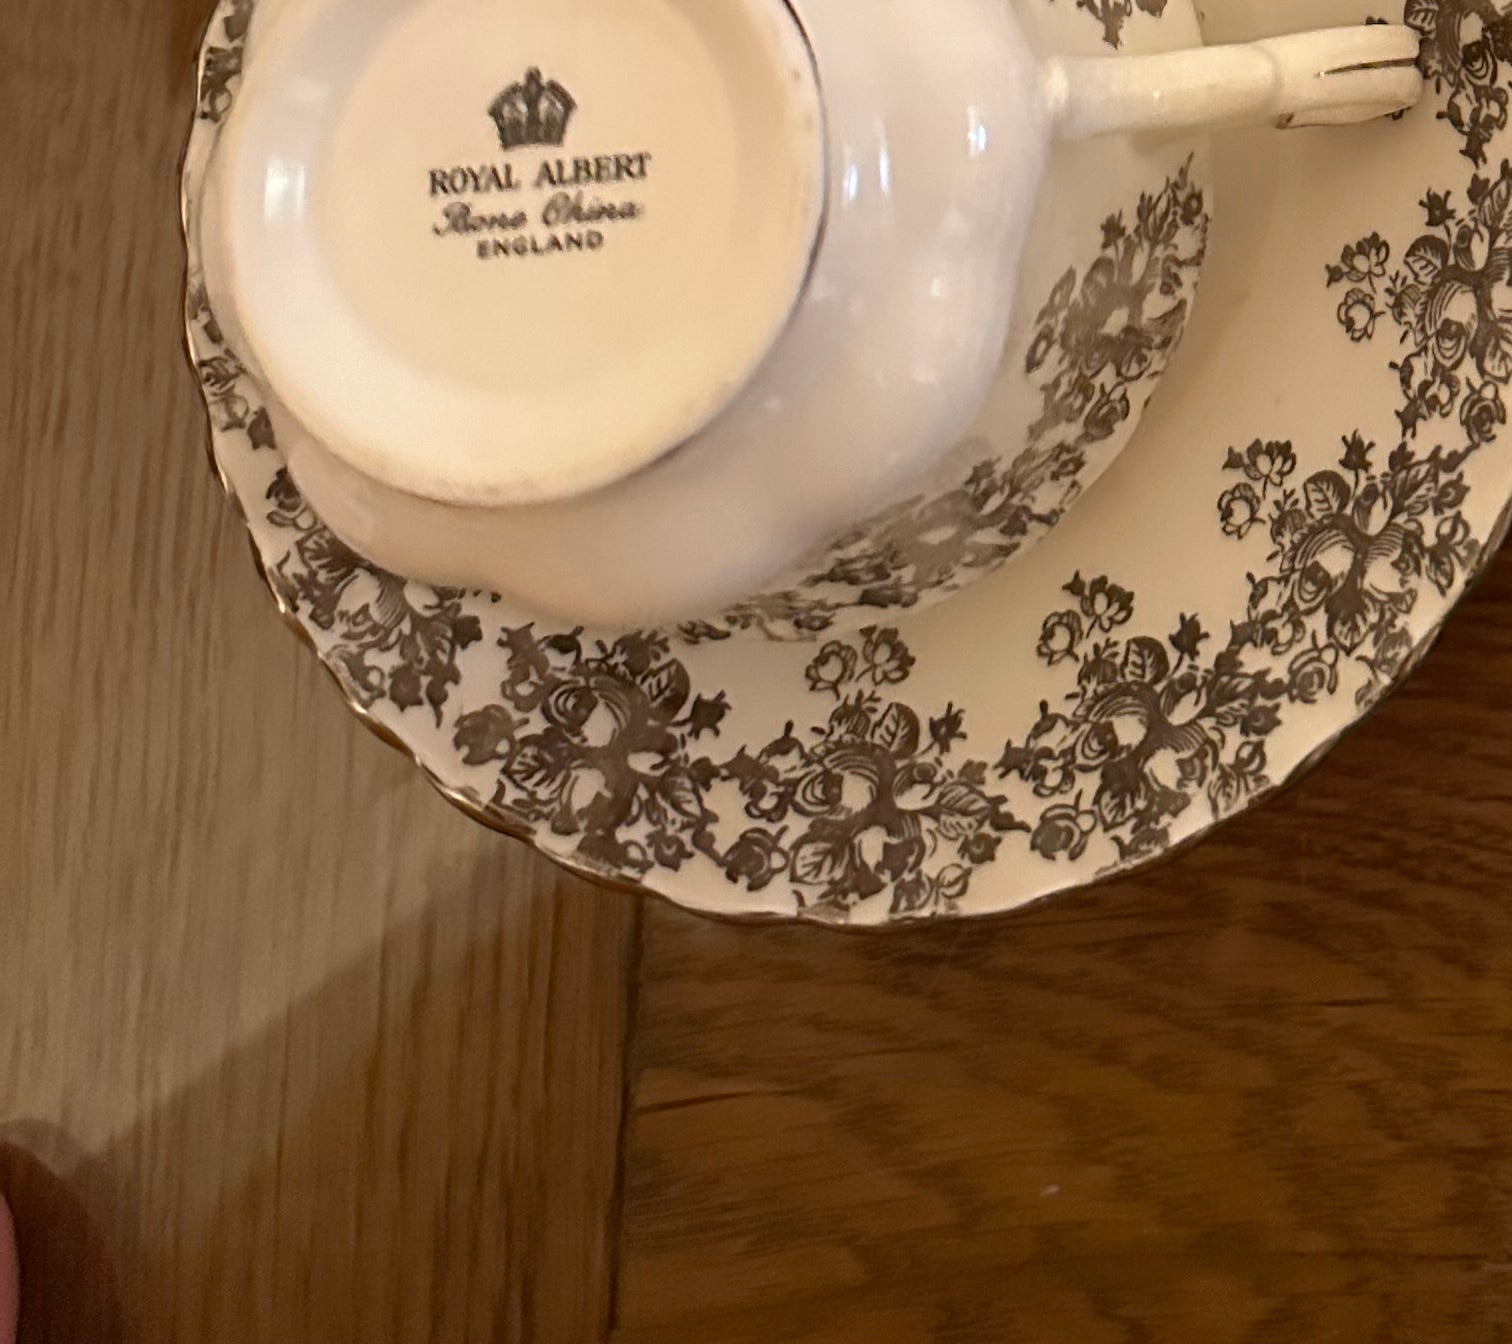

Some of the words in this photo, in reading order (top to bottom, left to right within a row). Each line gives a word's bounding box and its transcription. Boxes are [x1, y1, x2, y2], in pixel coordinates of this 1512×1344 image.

[428, 163, 520, 197] ROYAL
[533, 151, 651, 188] ALBERT
[433, 201, 527, 236] Bone
[542, 191, 643, 227] China
[477, 230, 604, 260] ENGLAND
